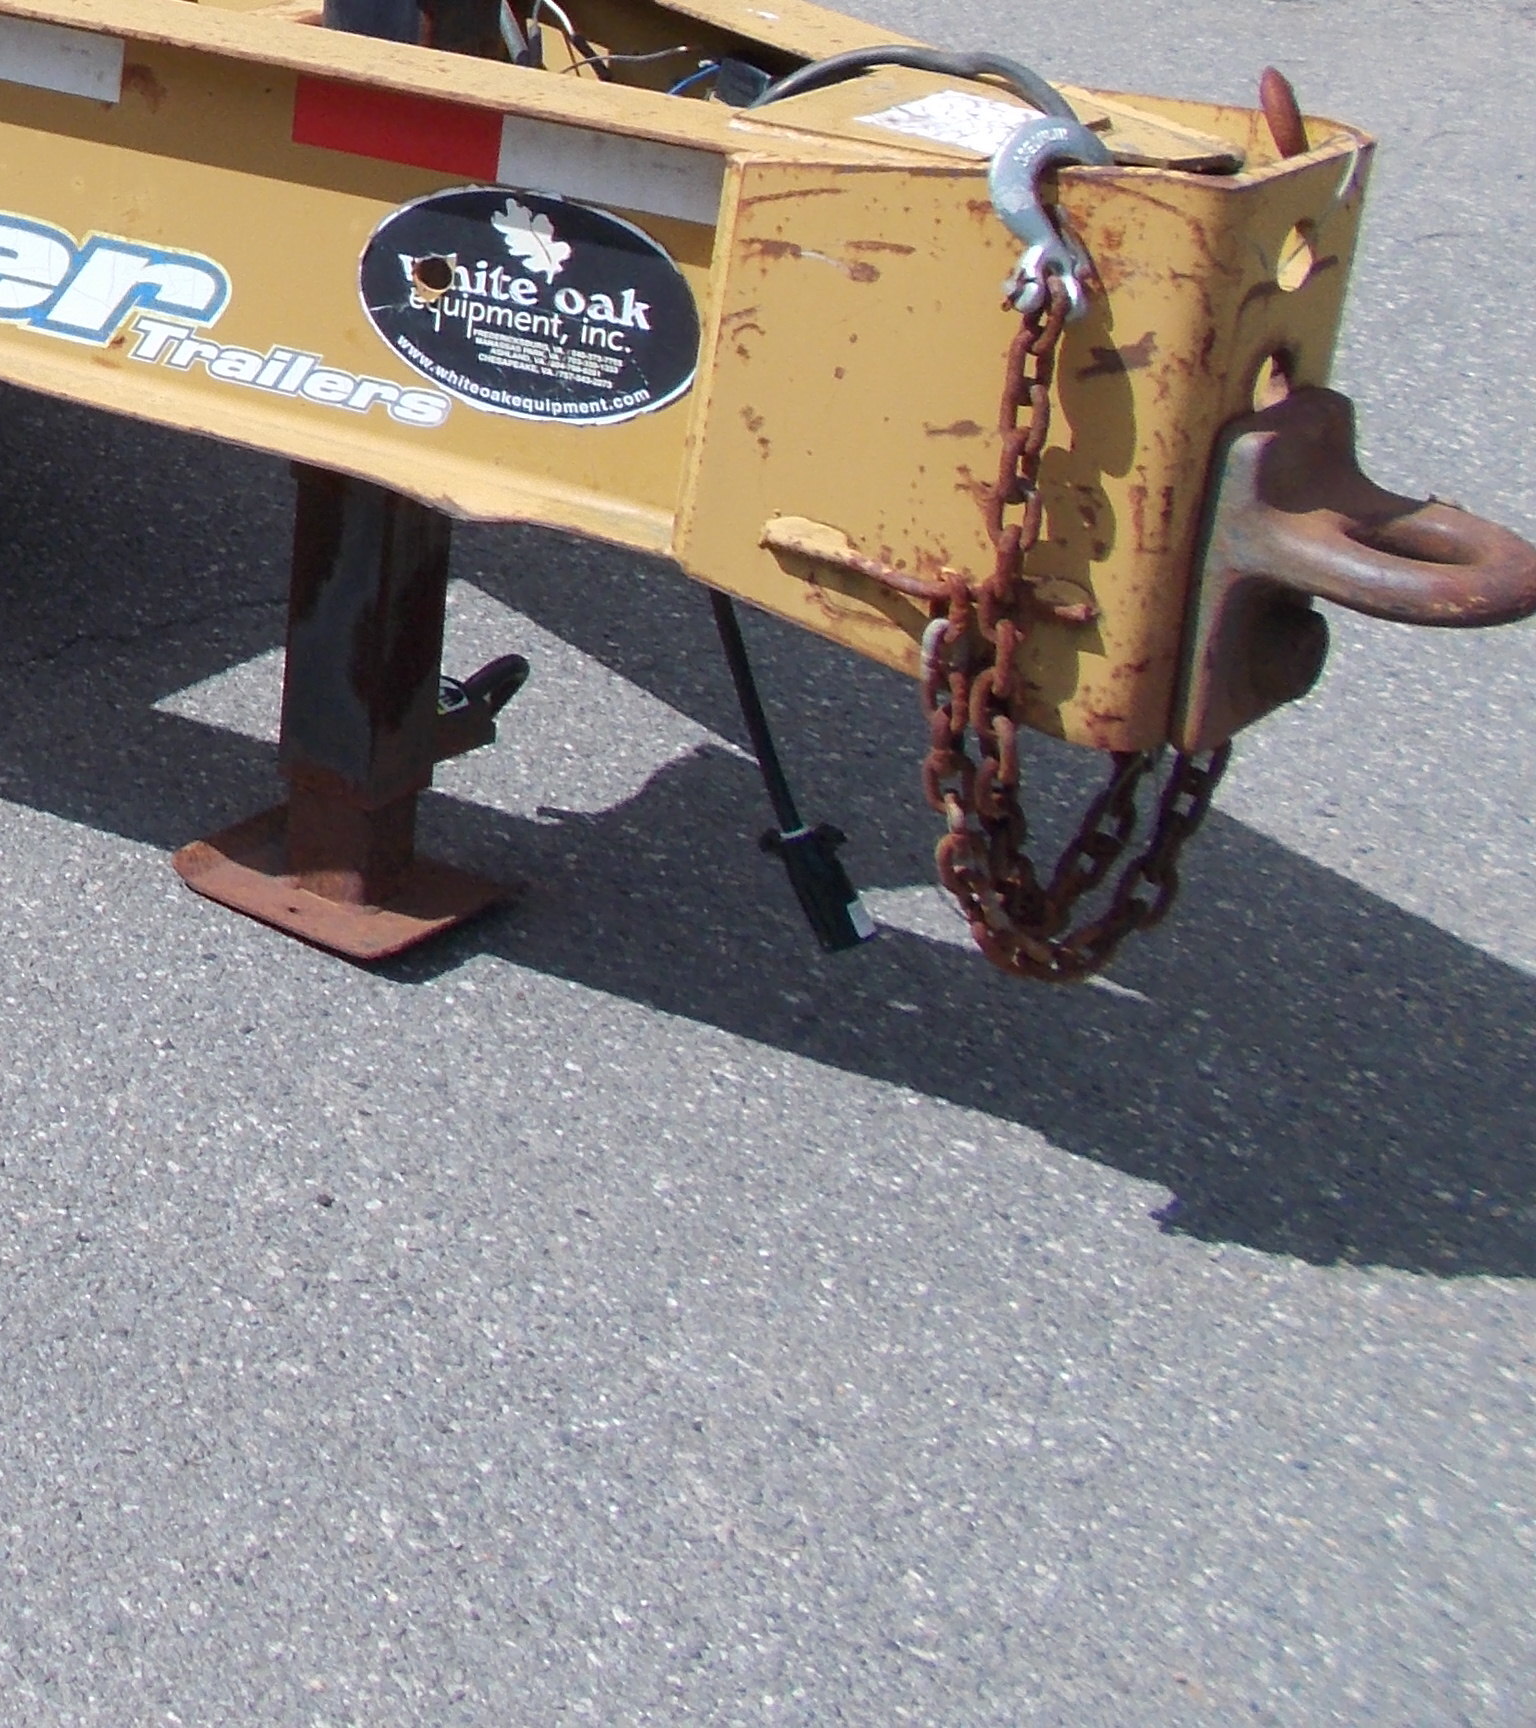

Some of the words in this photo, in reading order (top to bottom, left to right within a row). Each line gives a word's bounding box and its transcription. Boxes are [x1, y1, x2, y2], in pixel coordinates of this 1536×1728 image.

[554, 287, 652, 330] oak
[581, 317, 633, 353] inc.
[130, 316, 451, 426] Trailers
[396, 334, 652, 415] www.whiteoakequipment.com
